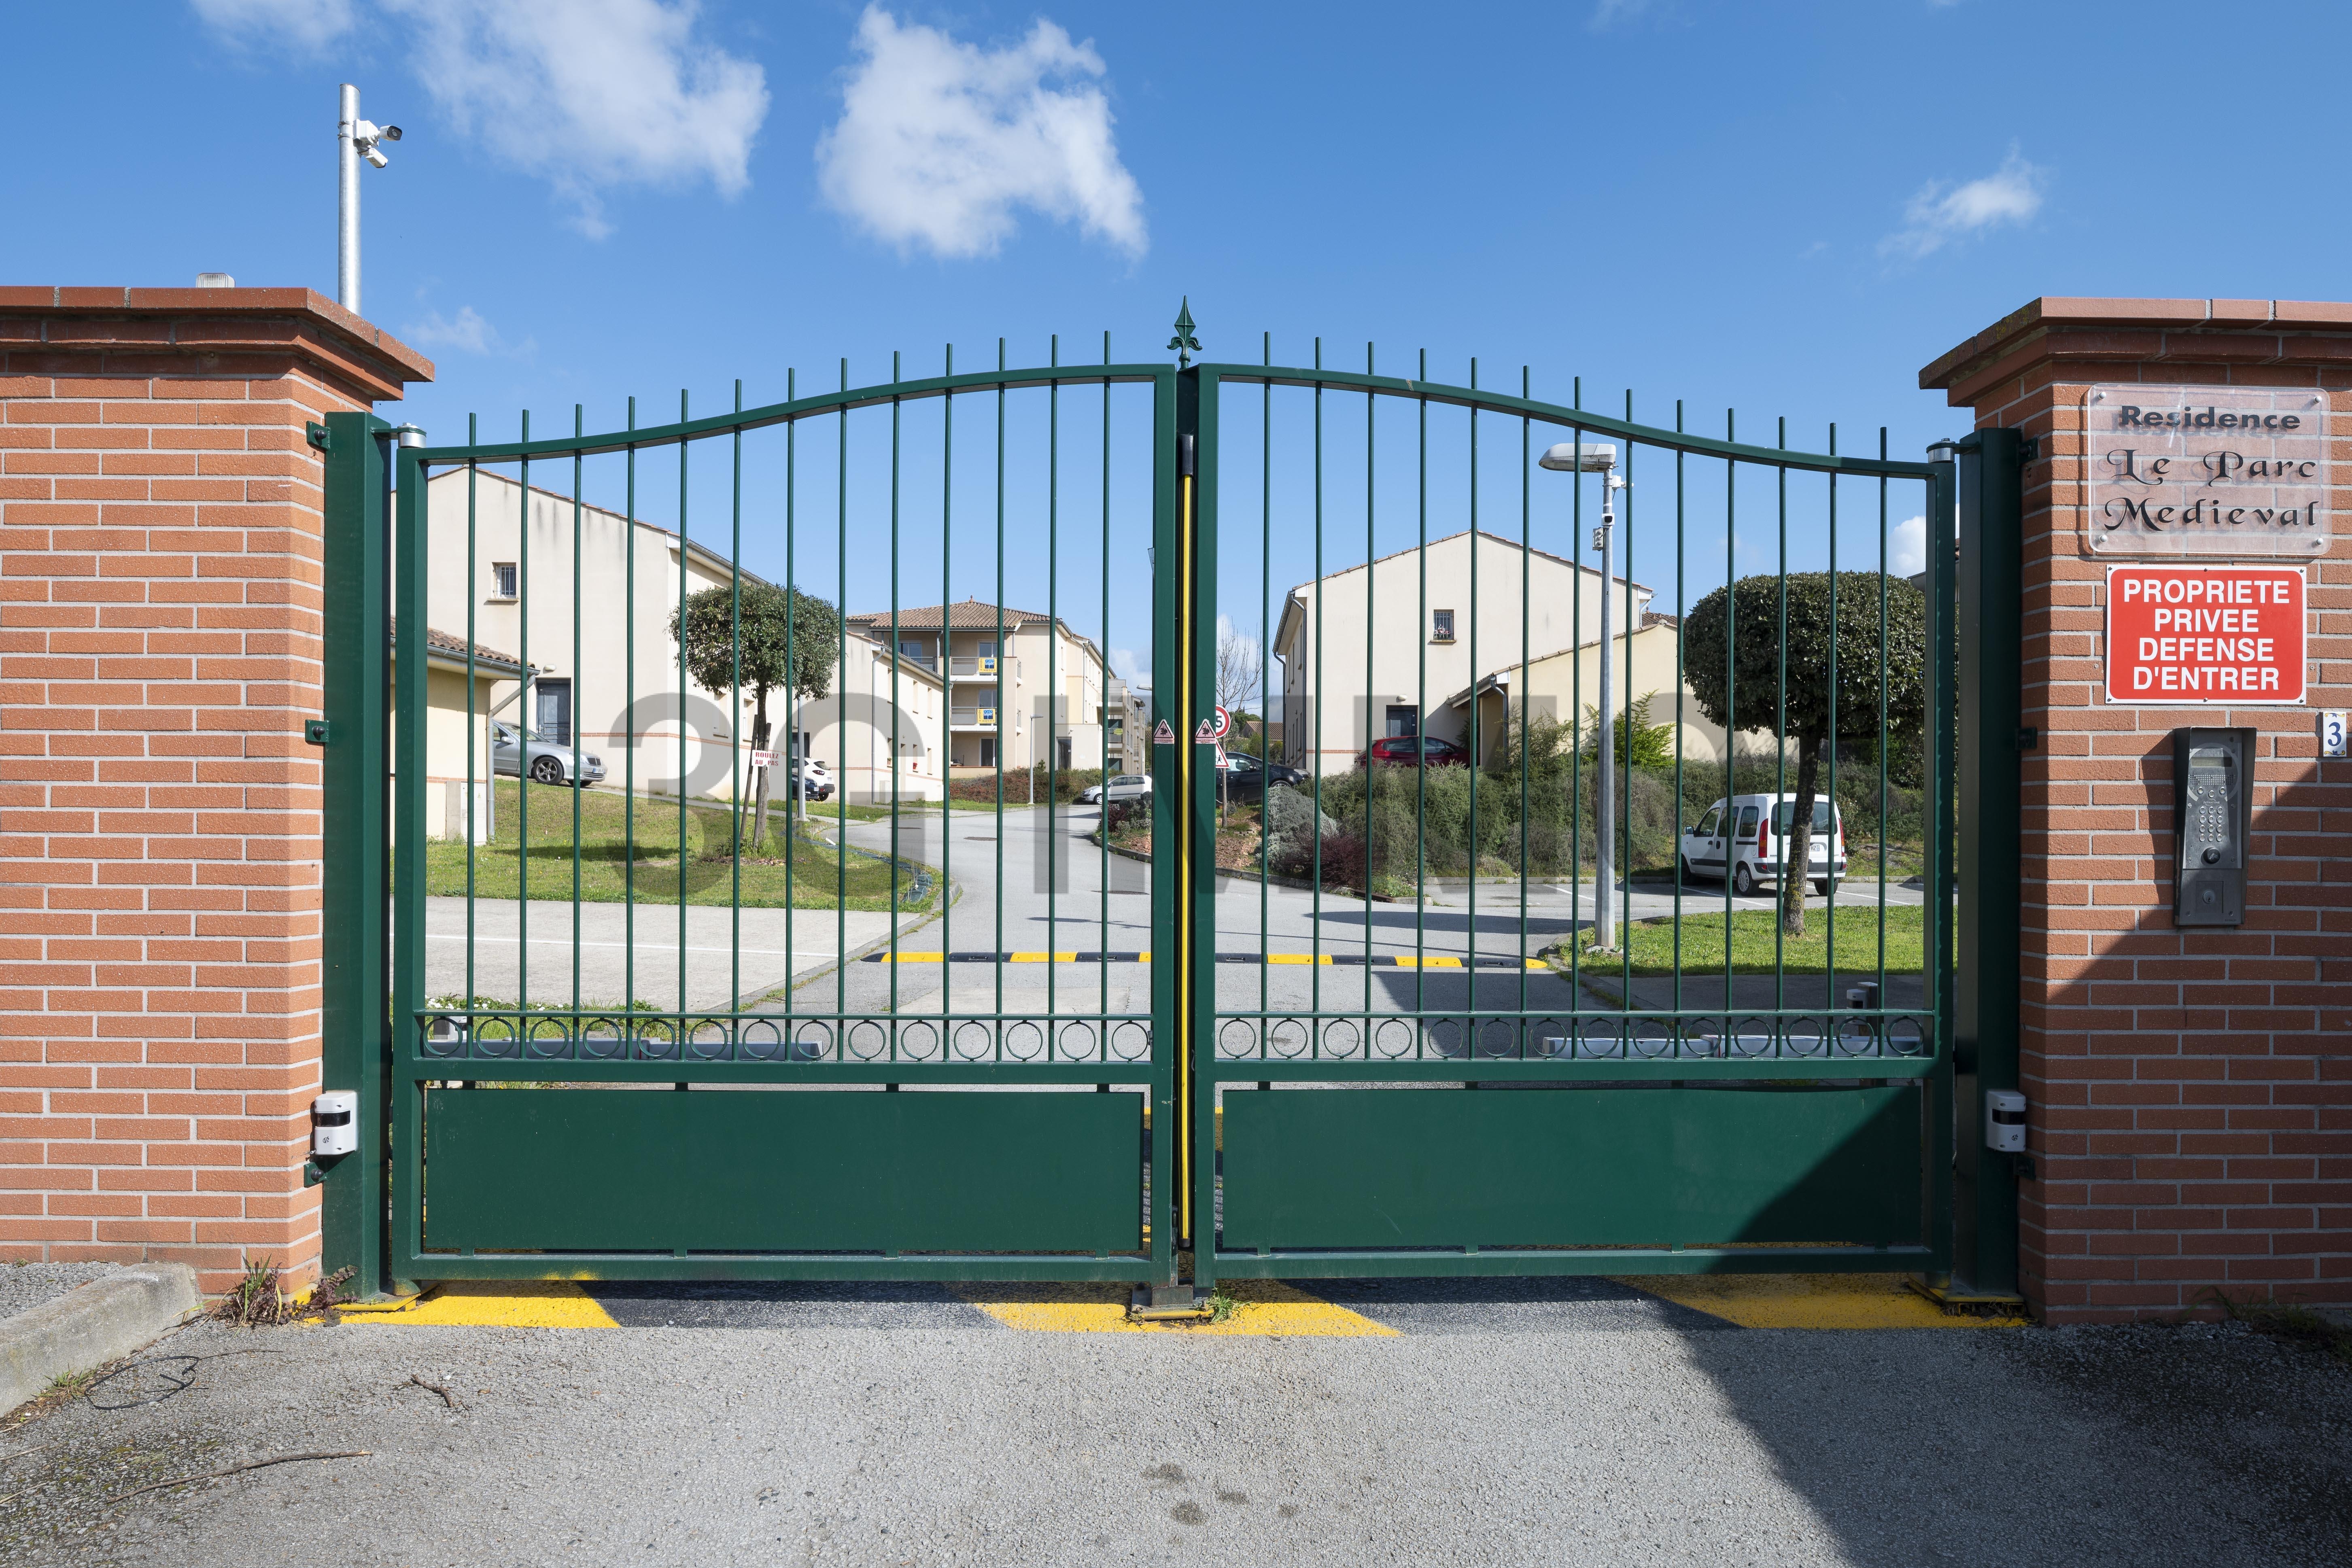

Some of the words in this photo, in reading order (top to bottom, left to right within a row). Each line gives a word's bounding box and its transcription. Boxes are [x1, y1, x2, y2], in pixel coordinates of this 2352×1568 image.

[2121, 405, 2301, 429] Residence
[2107, 449, 2171, 486] Le
[2203, 450, 2318, 488] Parc
[2104, 497, 2319, 532] Medieval
[2124, 579, 2289, 603] PROPRIETE
[2155, 608, 2259, 632] PRIVEE
[2139, 637, 2274, 662] DEFENSE
[2133, 666, 2279, 690] D'ENTRER
[1216, 715, 1223, 728] 5
[2327, 721, 2342, 747] 3
